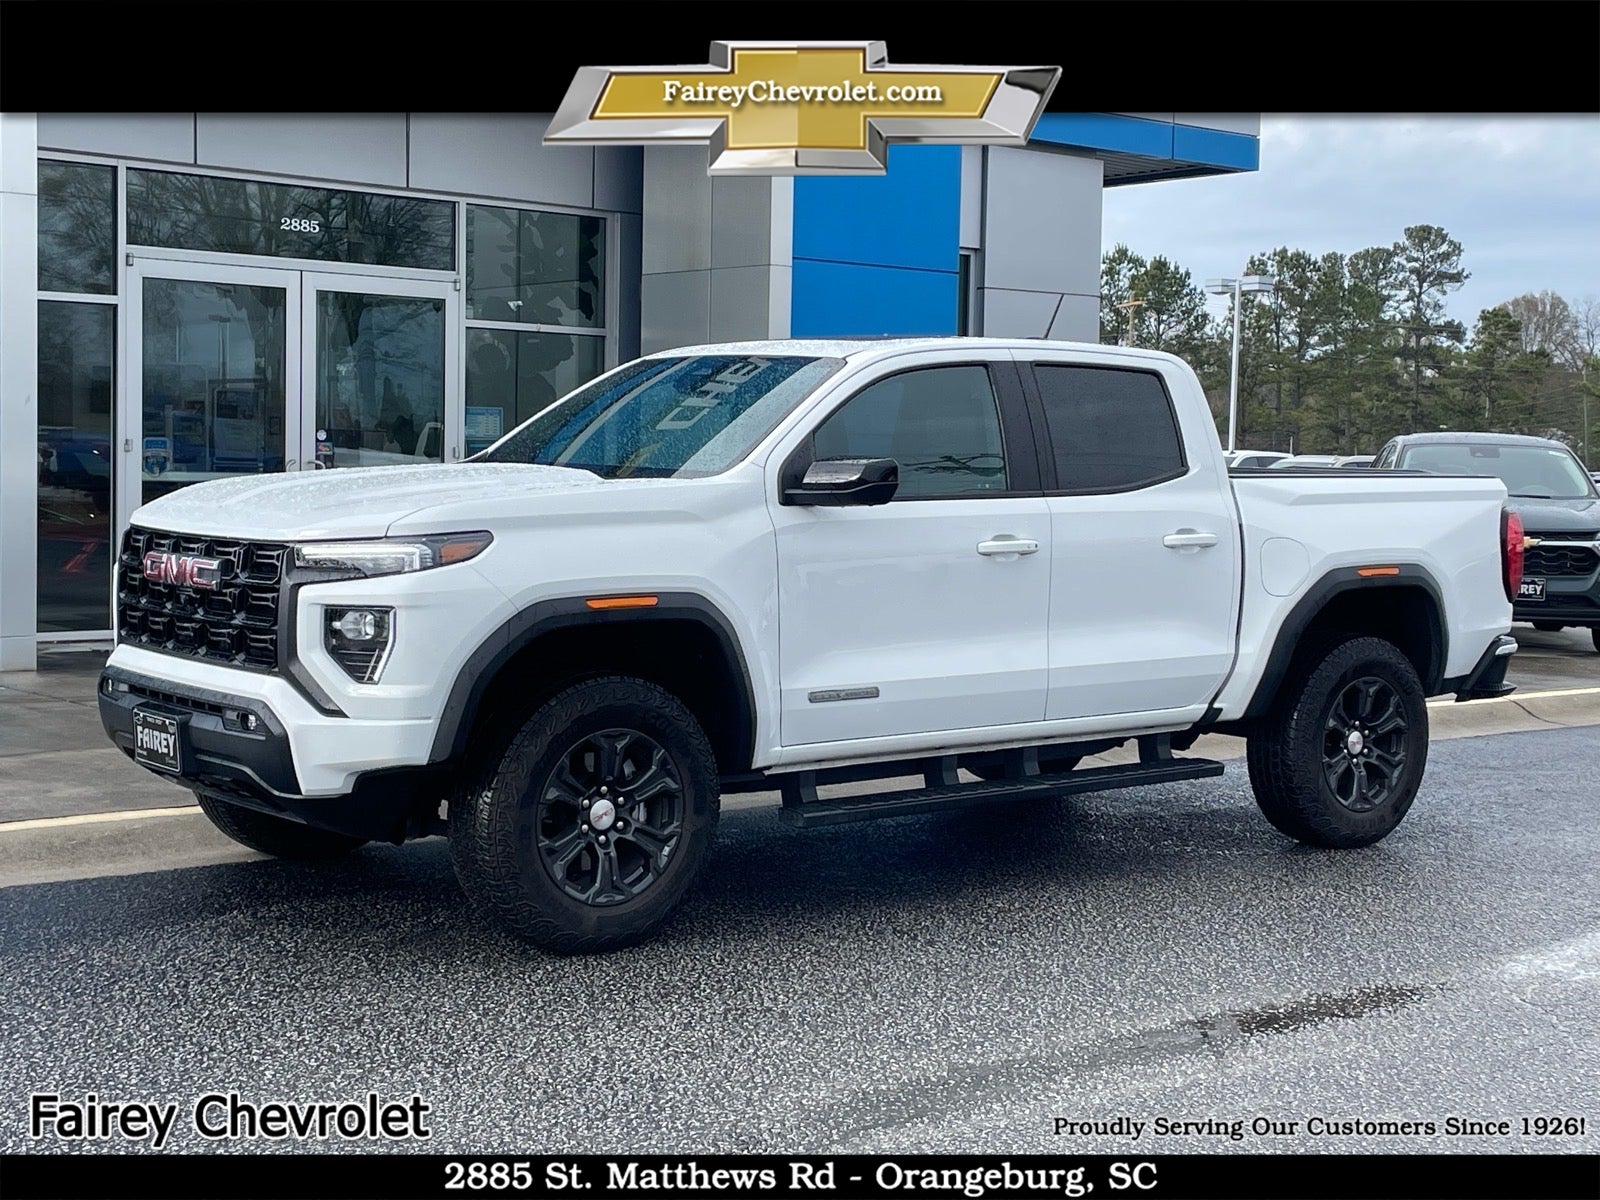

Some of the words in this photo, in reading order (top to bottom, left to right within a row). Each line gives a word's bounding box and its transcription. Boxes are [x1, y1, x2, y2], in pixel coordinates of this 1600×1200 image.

[280, 216, 320, 233] 2885
[143, 551, 220, 591] GMC
[1518, 584, 1543, 595] REY
[136, 725, 175, 757] FAIREY
